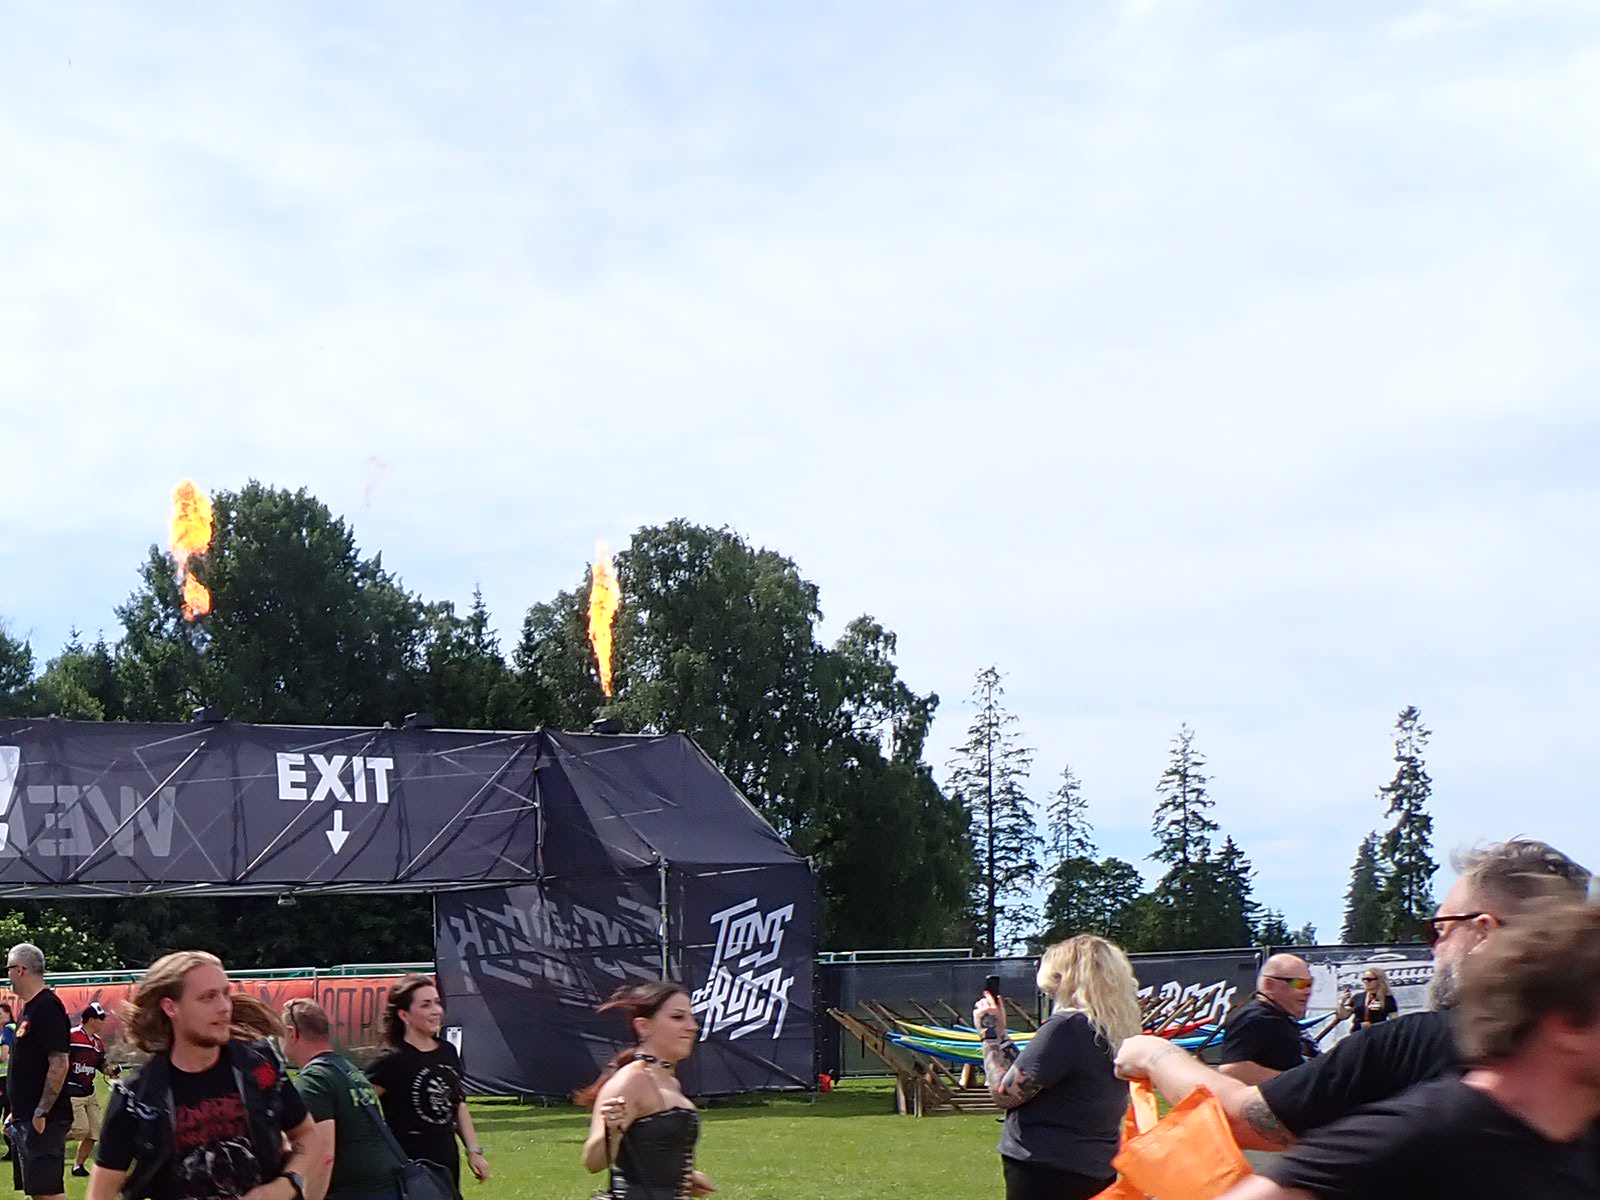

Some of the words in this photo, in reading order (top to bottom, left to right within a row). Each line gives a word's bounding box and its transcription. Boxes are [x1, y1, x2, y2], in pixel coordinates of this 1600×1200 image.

[276, 752, 394, 804] EXIT
[710, 897, 795, 981] TONS
[690, 966, 795, 1041] ROCK
